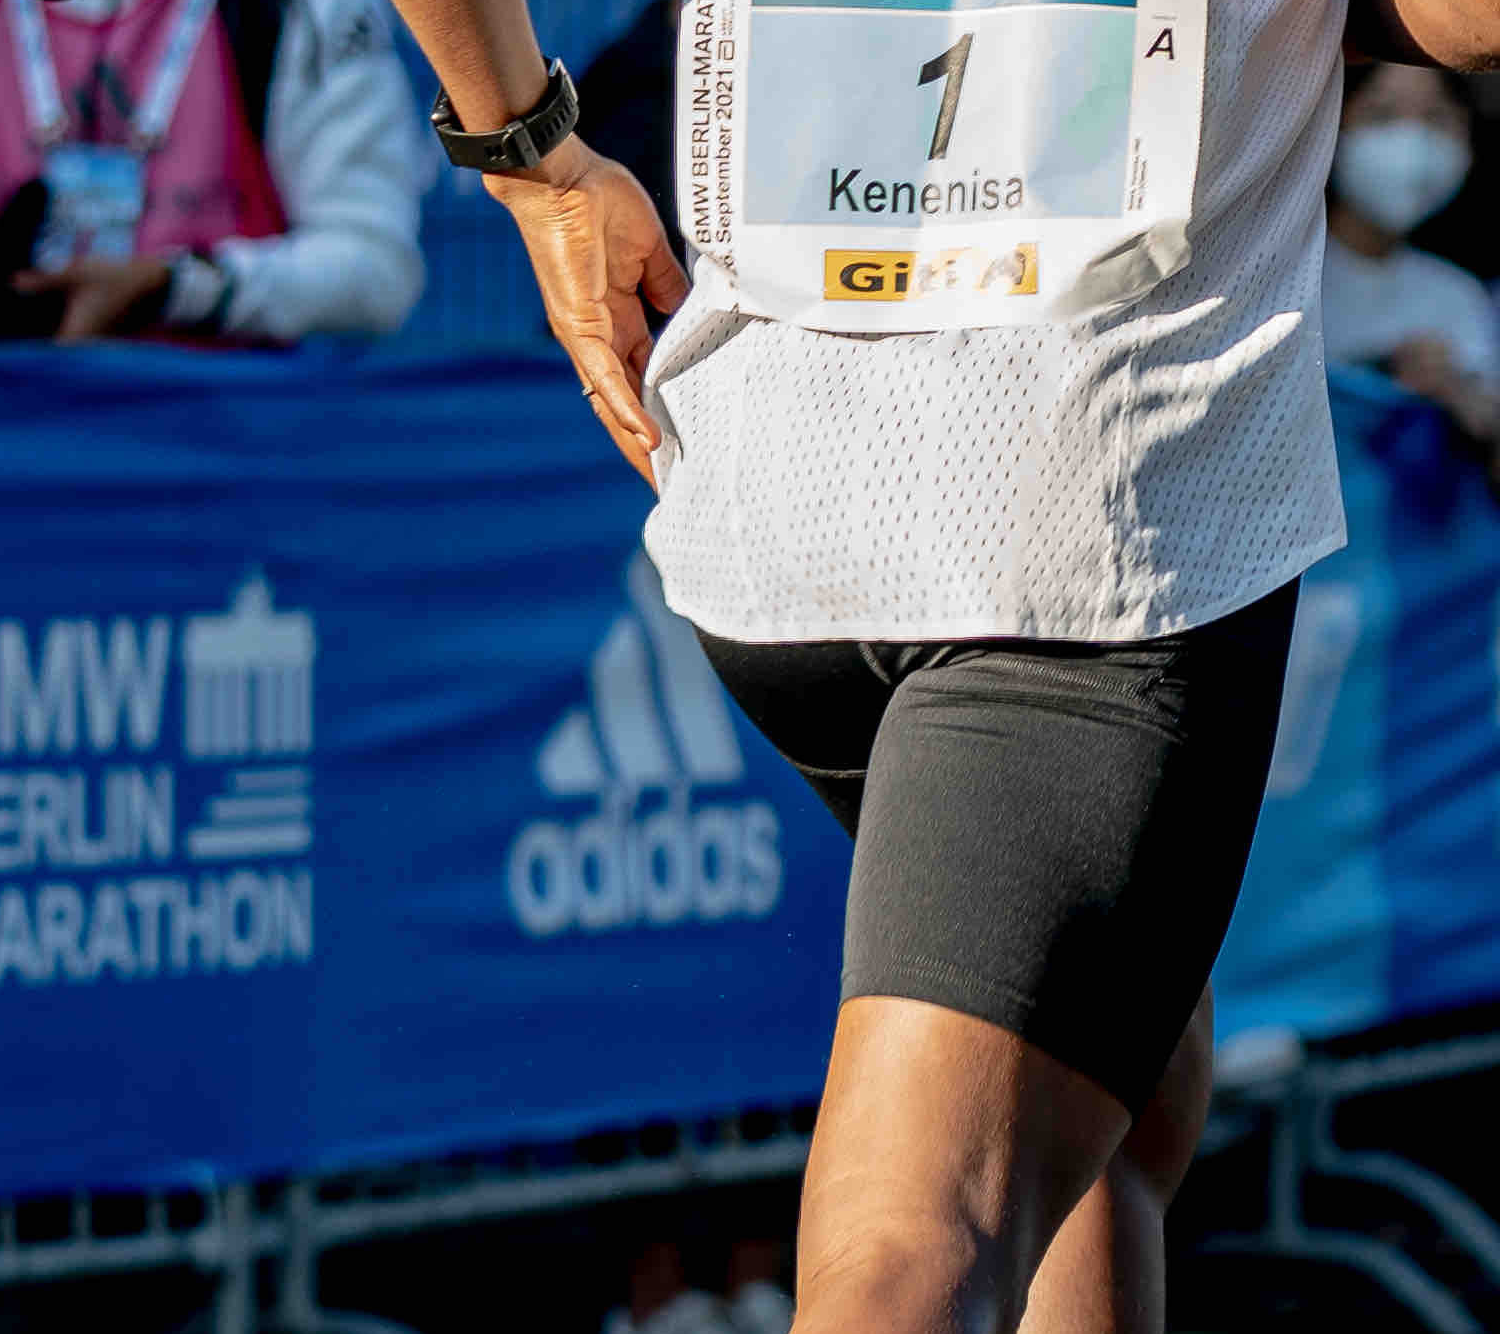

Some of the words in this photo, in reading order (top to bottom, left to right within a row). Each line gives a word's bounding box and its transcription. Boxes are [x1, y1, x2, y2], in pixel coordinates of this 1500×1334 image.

[1143, 27, 1174, 60] A
[716, 69, 732, 120] 2021
[917, 33, 975, 160] 1
[692, 181, 711, 244] BMW
[715, 125, 732, 244] September
[828, 168, 1024, 214] Kenenisa
[507, 784, 782, 939] adidas
